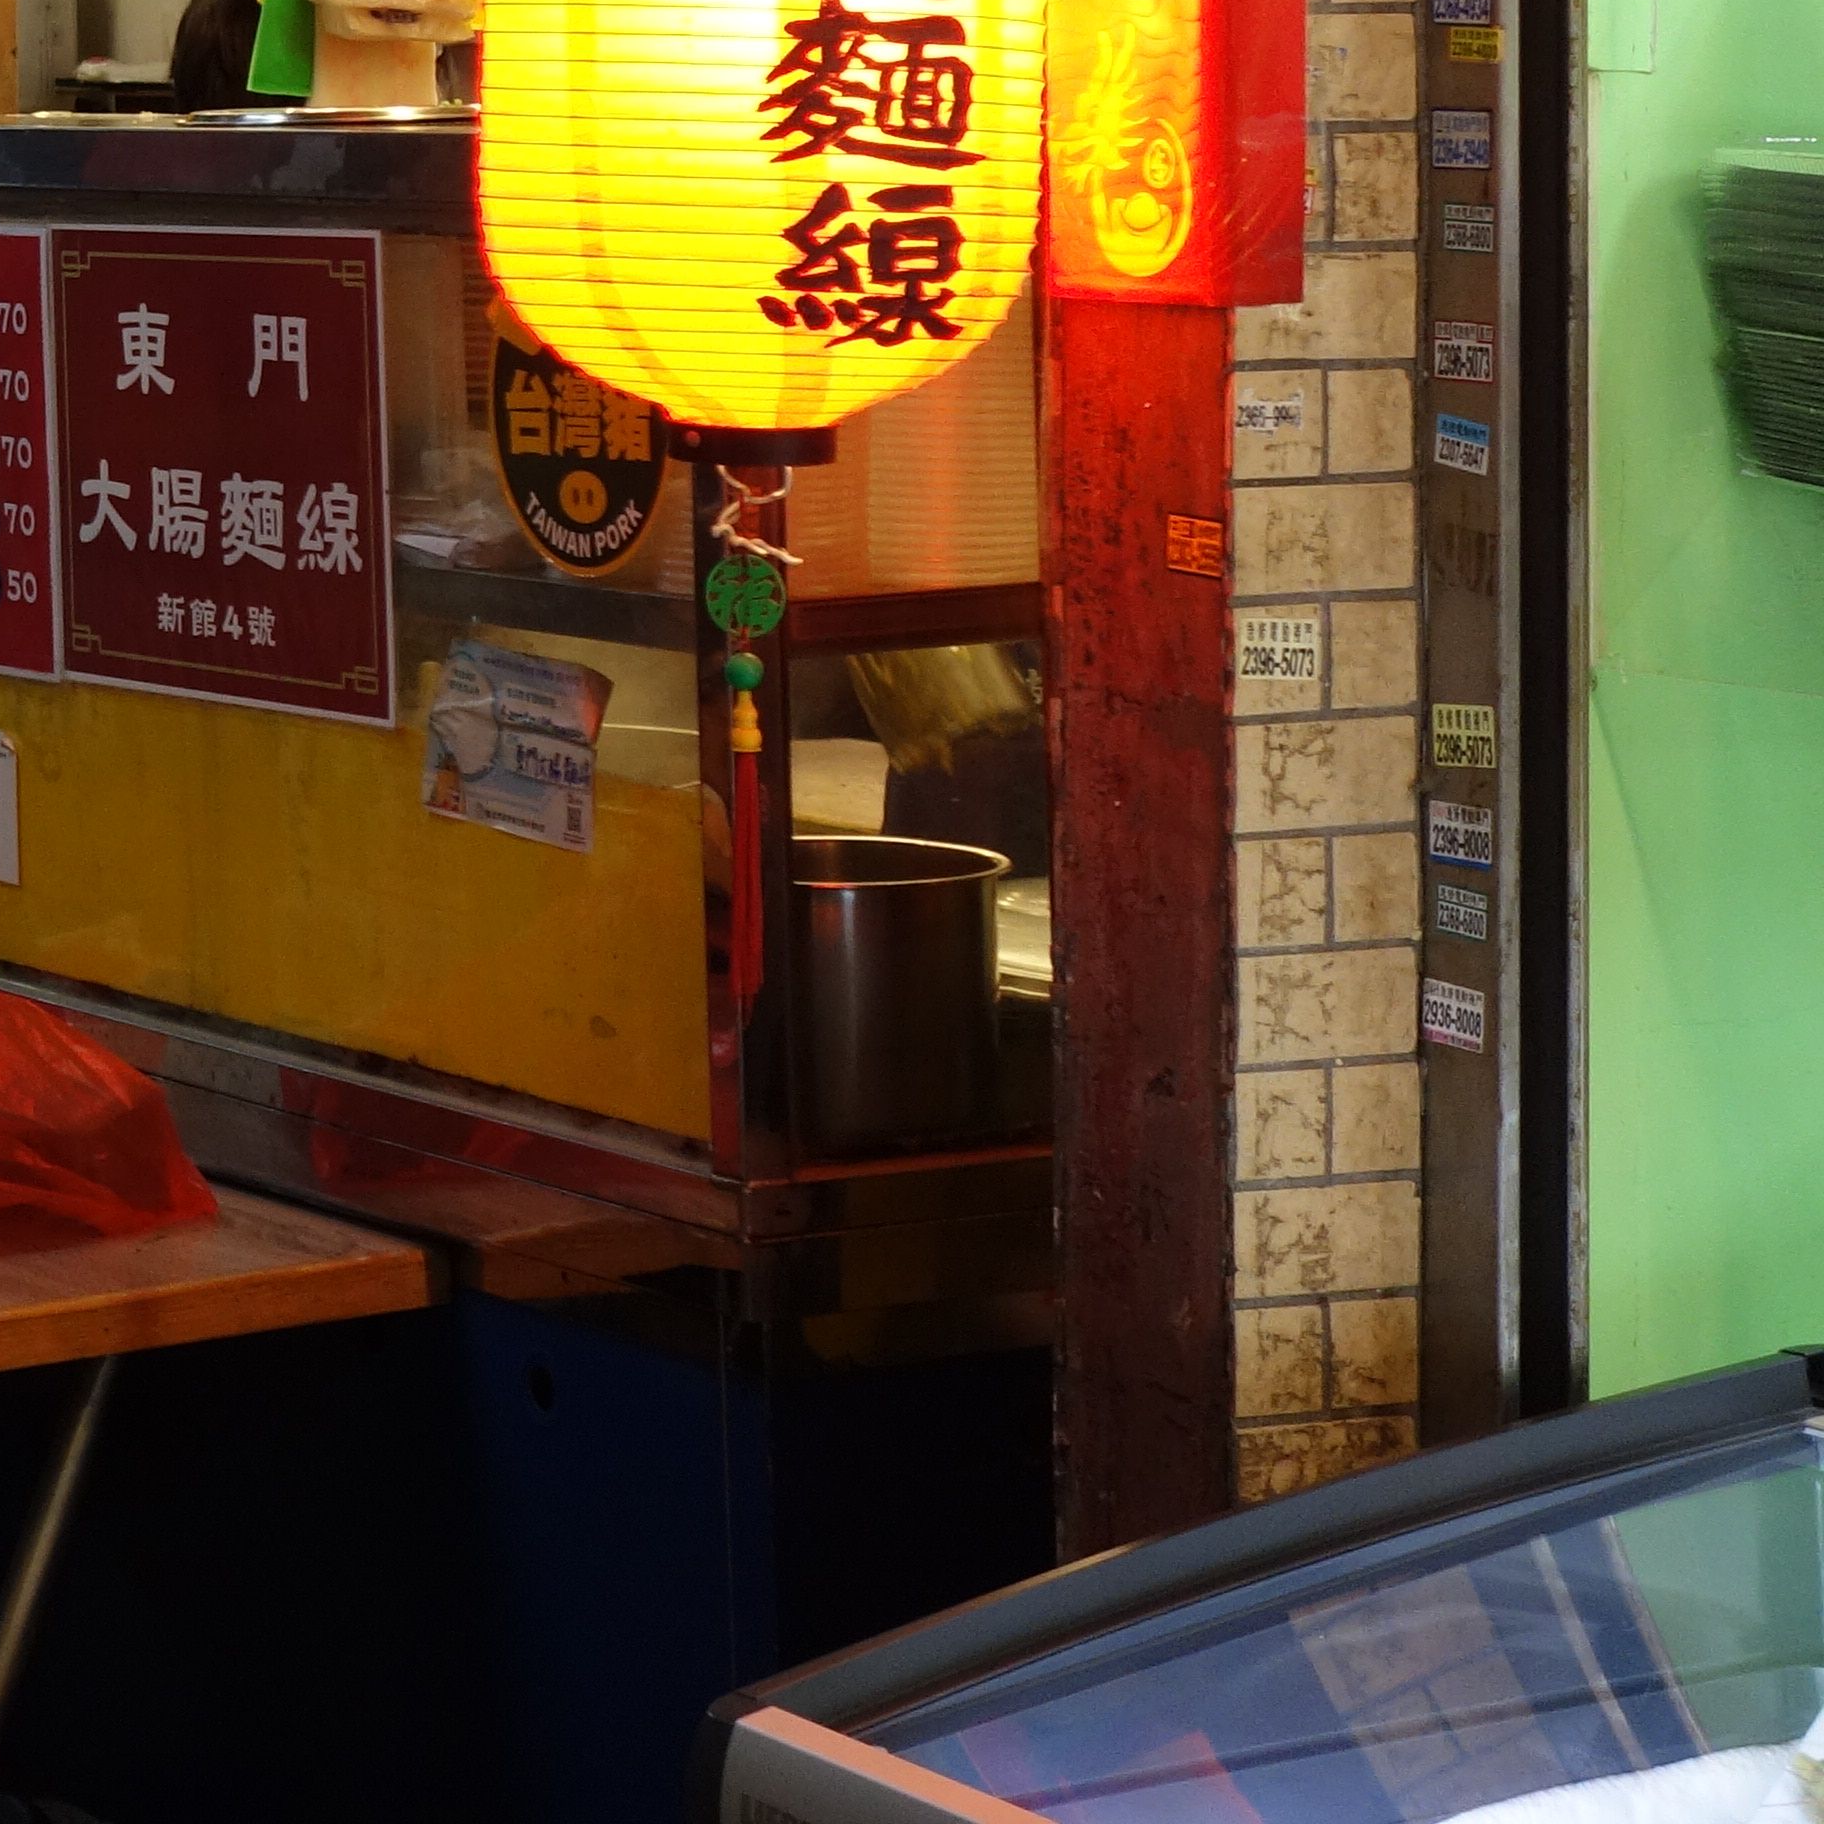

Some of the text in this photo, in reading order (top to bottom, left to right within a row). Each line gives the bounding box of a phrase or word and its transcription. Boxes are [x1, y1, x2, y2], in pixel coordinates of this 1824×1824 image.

[0, 368, 30, 403] 70
[1, 435, 33, 470] 70
[3, 502, 36, 537] 70
[80, 459, 363, 575] 大腸麵線
[525, 490, 644, 559] TAIWAN PORK
[6, 569, 38, 604] 50
[157, 592, 277, 648] 新館4號
[1241, 646, 1315, 678] 2396-5073
[1436, 733, 1493, 767] 2396-5073
[1423, 998, 1482, 1038] 2936-8008
